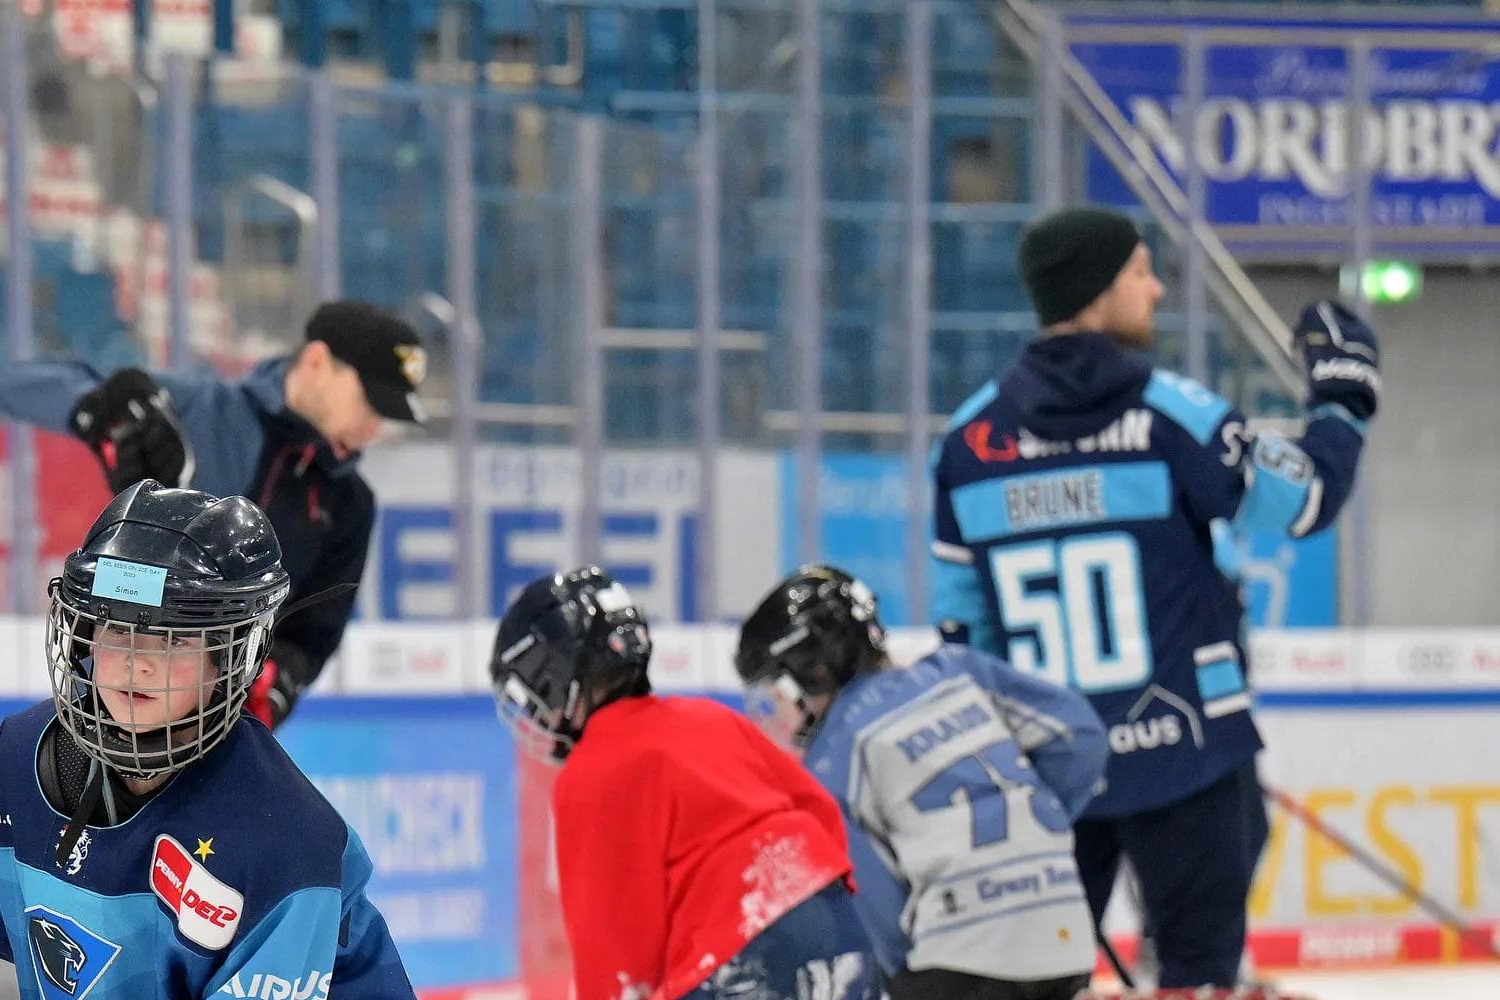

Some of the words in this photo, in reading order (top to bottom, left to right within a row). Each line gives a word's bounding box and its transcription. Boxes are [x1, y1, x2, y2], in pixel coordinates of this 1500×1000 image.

[1005, 470, 1105, 532] BRUNE
[115, 585, 139, 597] Simon
[988, 530, 1153, 690] 50
[181, 888, 238, 929] DEL
